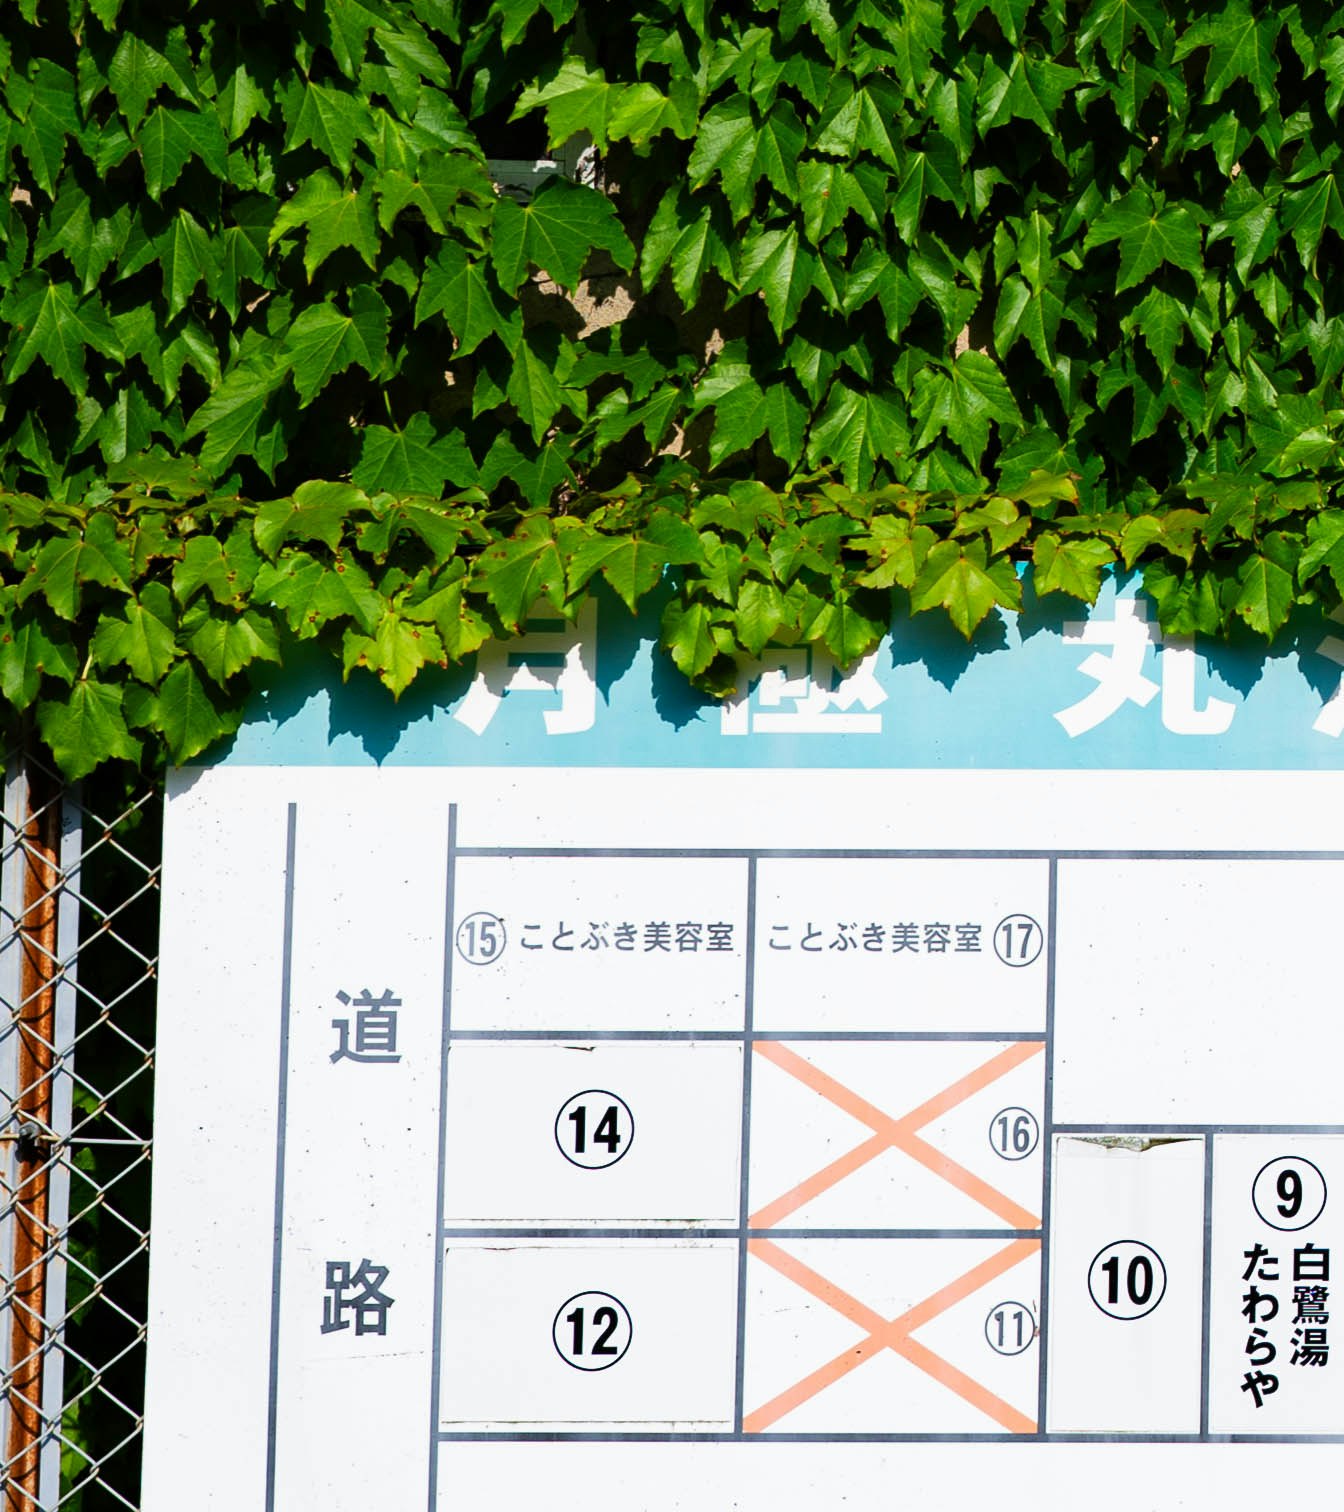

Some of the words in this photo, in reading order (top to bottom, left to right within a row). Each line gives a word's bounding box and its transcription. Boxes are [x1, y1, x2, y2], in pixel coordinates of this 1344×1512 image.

[520, 921, 735, 953] ことぶき美容室
[769, 921, 983, 954] ことぶき美容室
[318, 988, 403, 1337] 道路
[1239, 1241, 1281, 1410] たわらや
[1289, 1241, 1331, 1368] 白鷺湯
